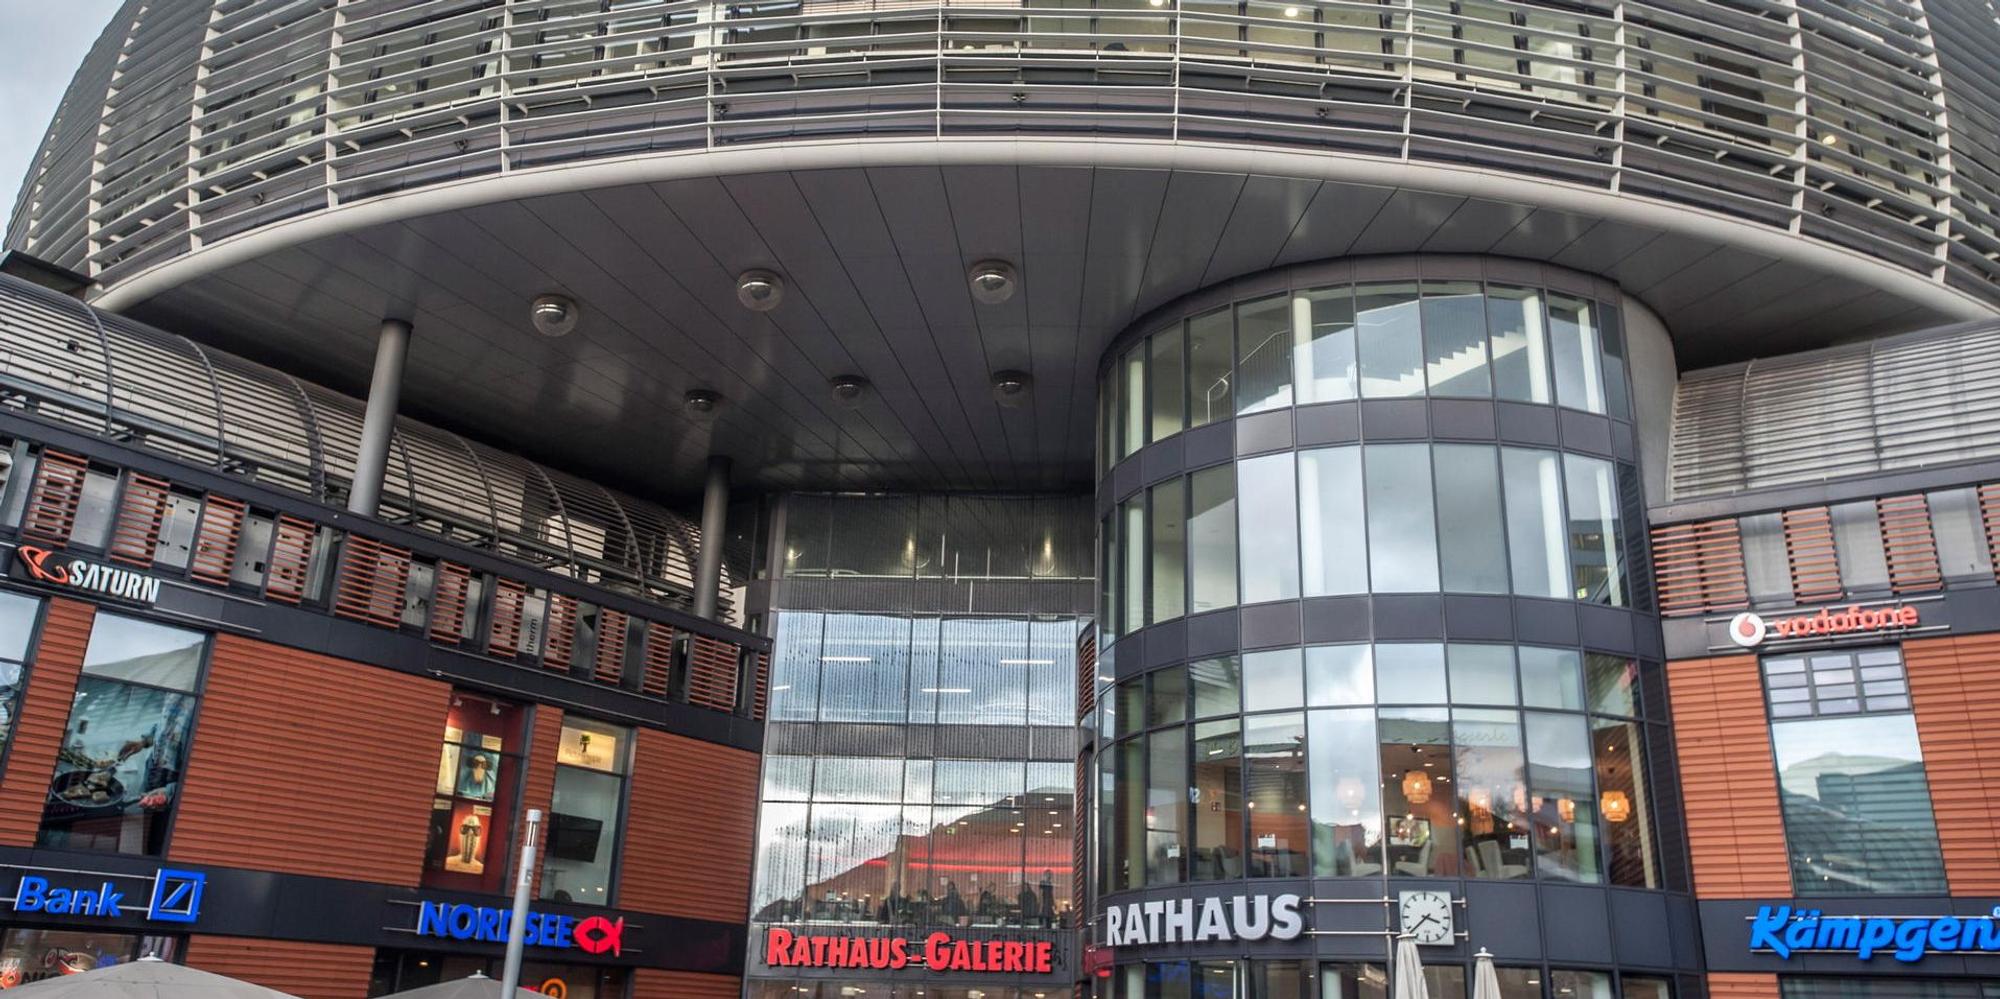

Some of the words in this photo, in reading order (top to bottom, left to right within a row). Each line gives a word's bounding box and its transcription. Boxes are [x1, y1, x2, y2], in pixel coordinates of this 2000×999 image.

[69, 560, 160, 602] SATURN
[1776, 605, 1918, 637] vodafone
[13, 875, 125, 917] Bank
[1106, 894, 1303, 946] RATHAUS
[1750, 905, 2000, 961] Kämpgen
